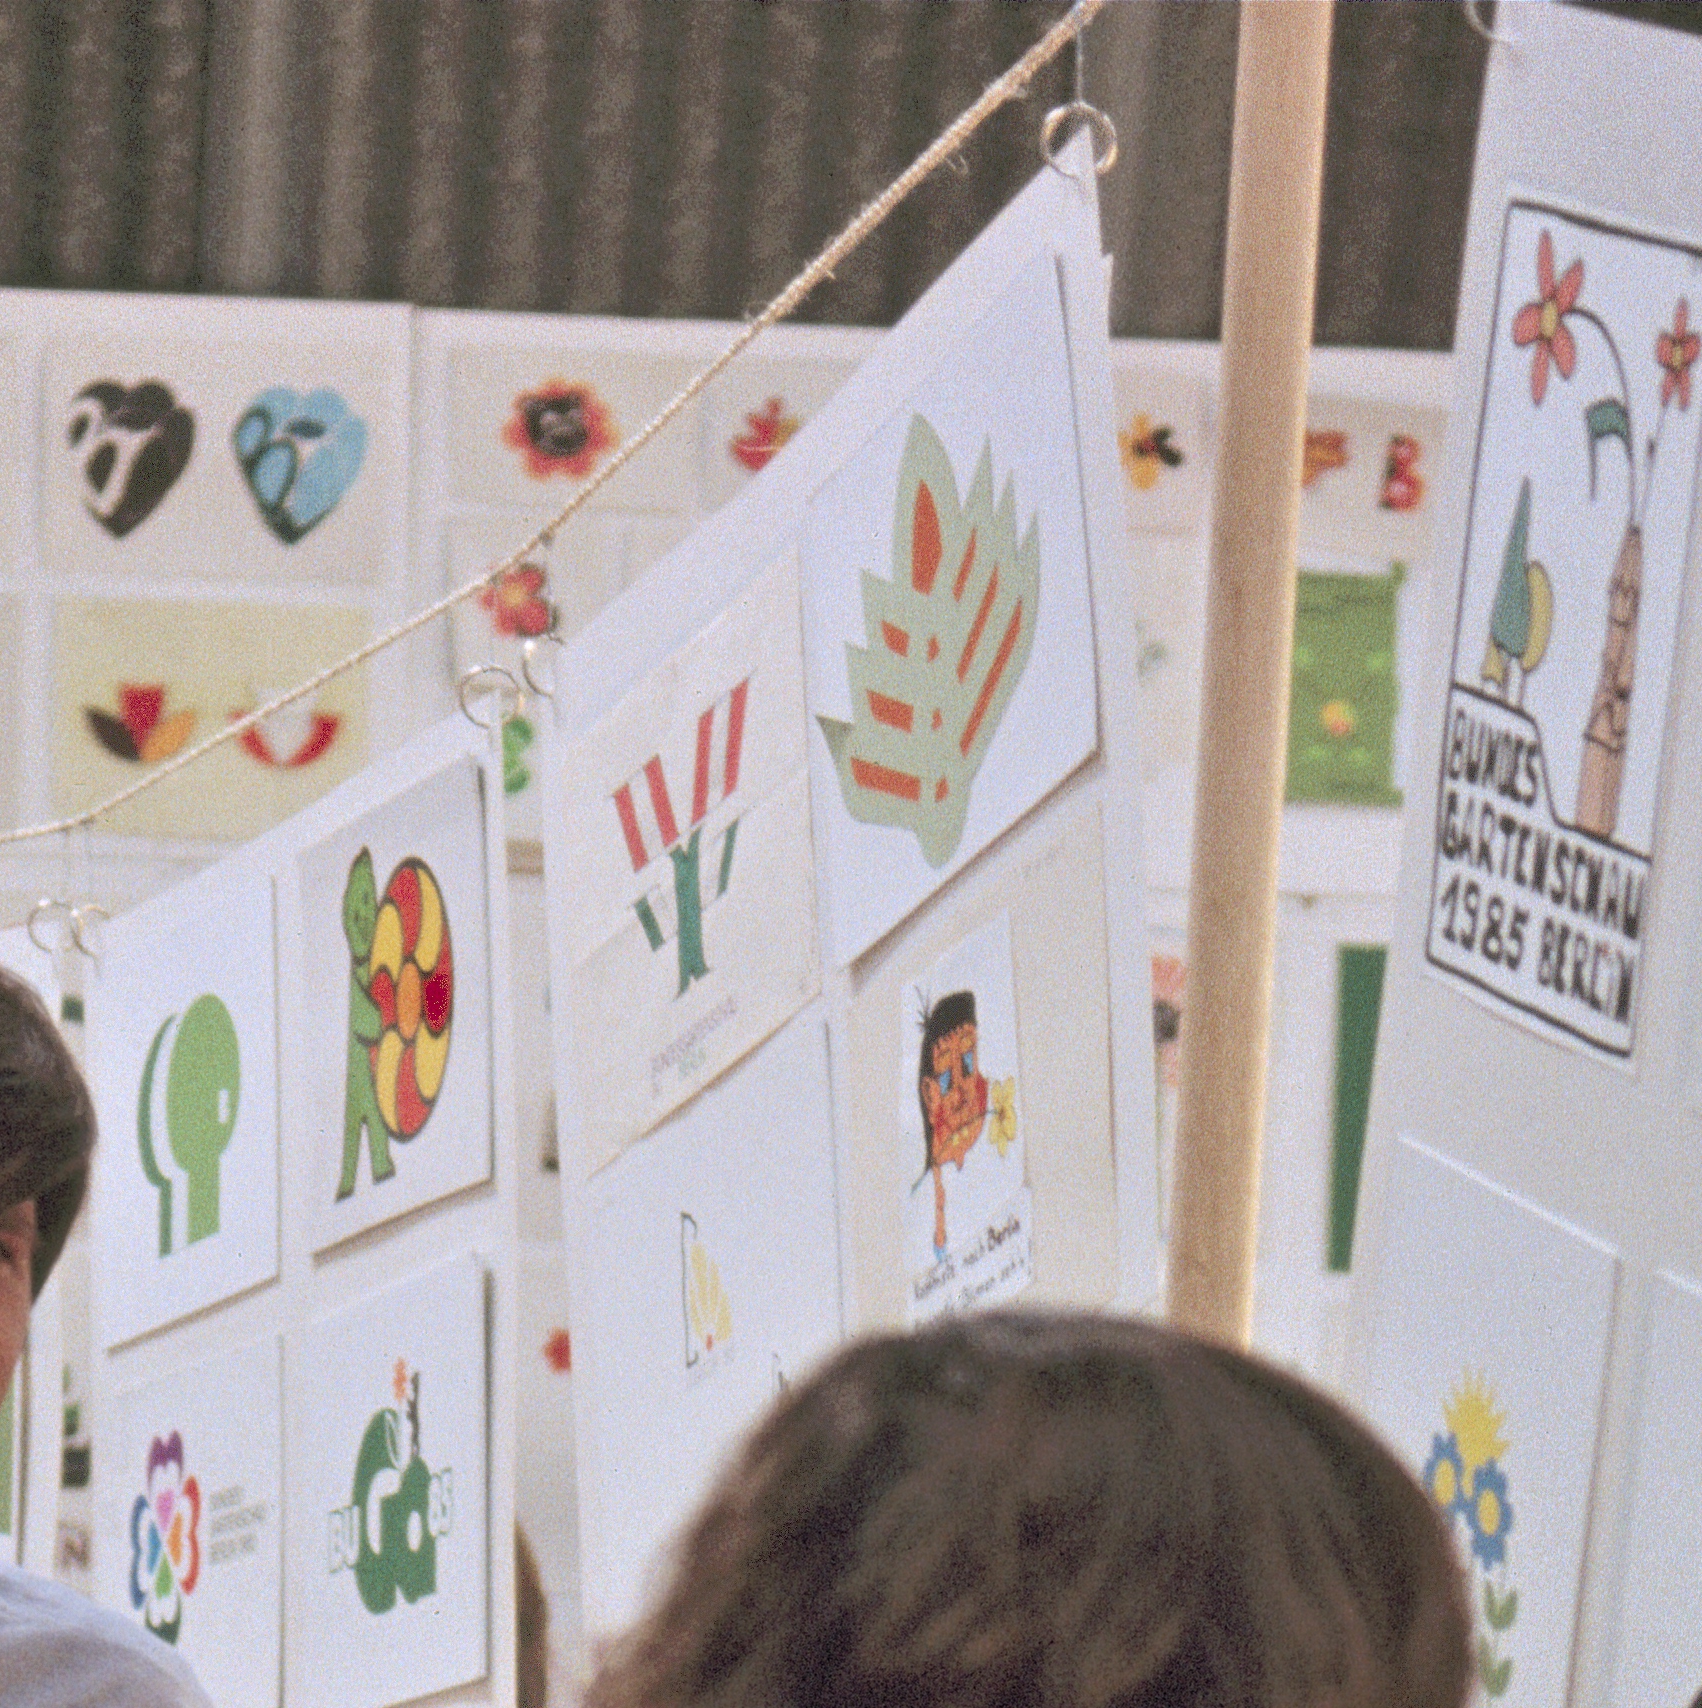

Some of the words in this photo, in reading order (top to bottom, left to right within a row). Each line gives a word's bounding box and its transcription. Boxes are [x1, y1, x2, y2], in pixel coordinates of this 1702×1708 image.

[1448, 706, 1541, 808] BUNDES
[1439, 790, 1645, 939] GARTENSCHAU
[1441, 873, 1529, 971] 1985
